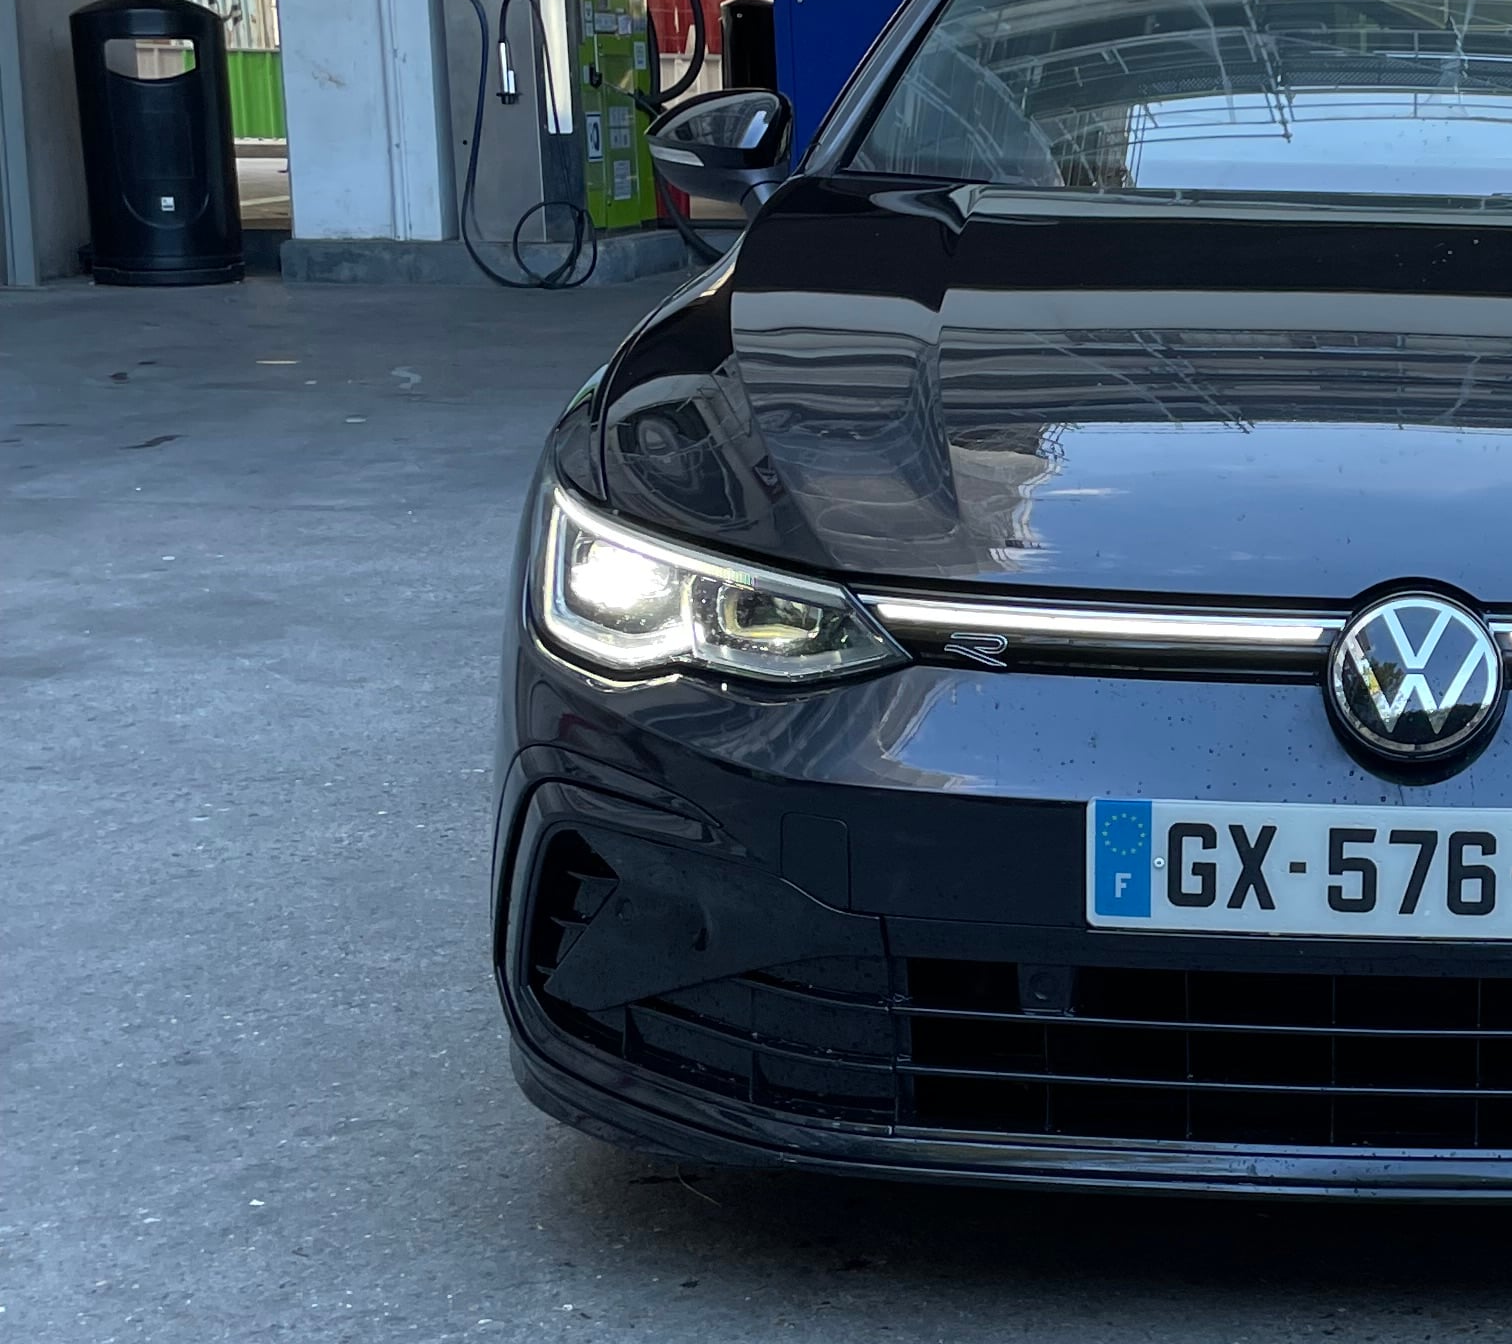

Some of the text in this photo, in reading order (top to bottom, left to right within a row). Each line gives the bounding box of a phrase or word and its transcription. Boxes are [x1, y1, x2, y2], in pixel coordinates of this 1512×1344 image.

[943, 631, 1008, 668] R
[1344, 605, 1489, 735] VW
[1114, 872, 1132, 899] F
